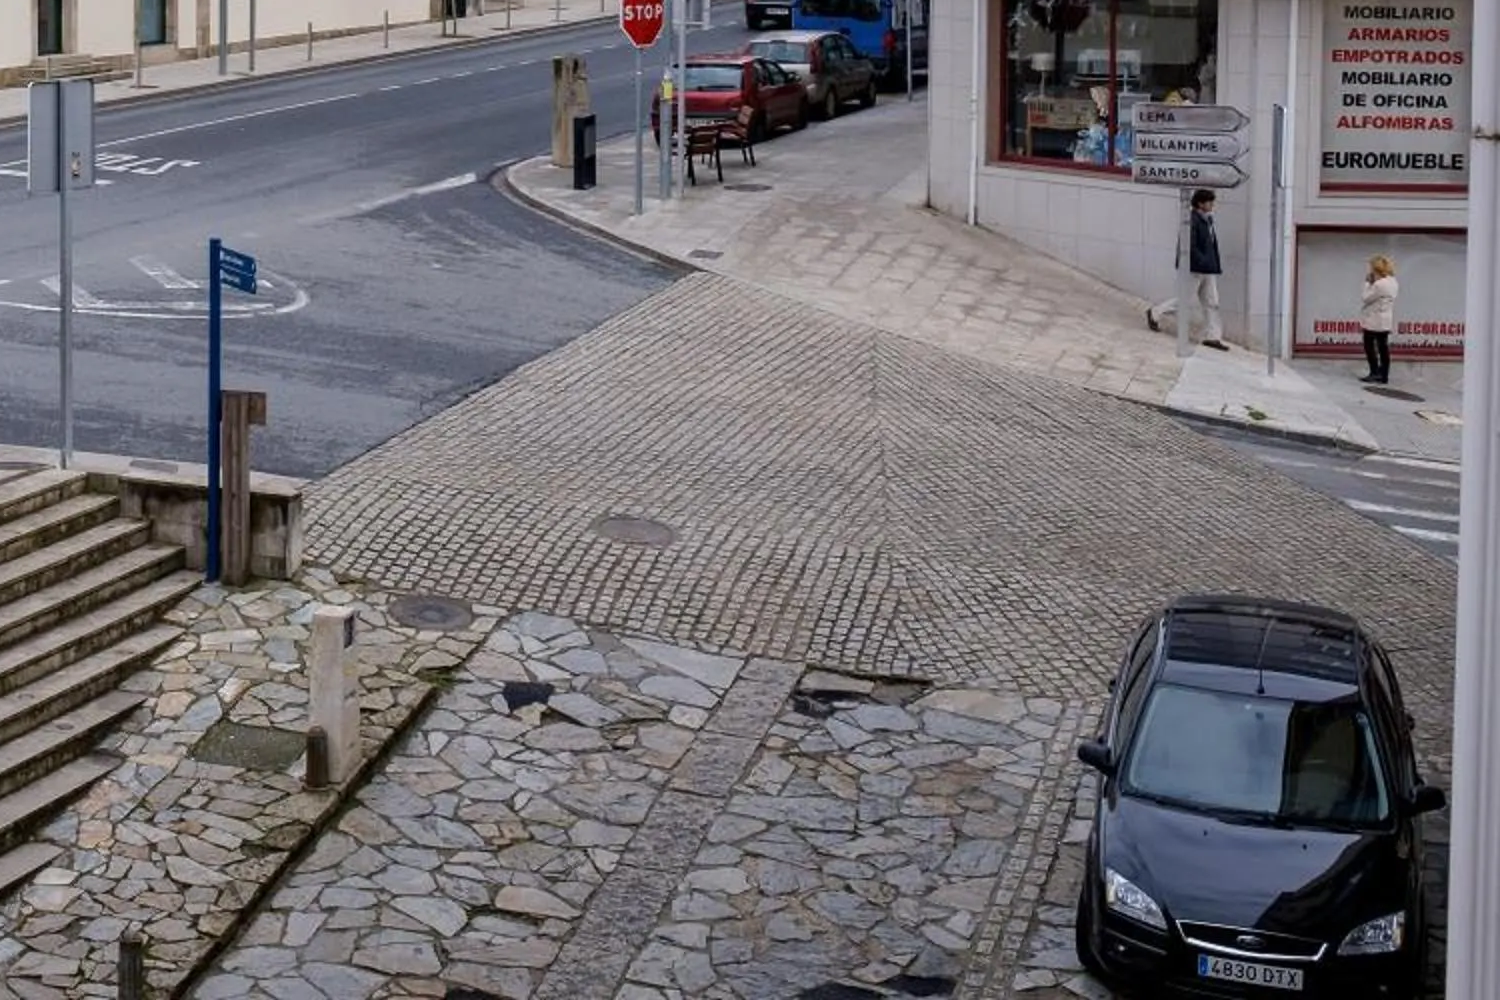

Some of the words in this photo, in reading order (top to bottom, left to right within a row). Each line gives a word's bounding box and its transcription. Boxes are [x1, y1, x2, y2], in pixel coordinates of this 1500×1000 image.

[624, 3, 664, 21] STOP
[1344, 5, 1456, 21] MOBILIARIO
[1347, 27, 1451, 43] ARMARIOS
[1331, 49, 1465, 65] EMPOTRADOS
[1341, 71, 1453, 87] MOBILIARIO
[1342, 93, 1366, 108] DE
[1373, 93, 1449, 109] OFICINA
[1139, 110, 1177, 123] LEMA
[1336, 115, 1455, 131] ALFOMBRAS
[1139, 138, 1220, 153] VILLANTIME
[1322, 152, 1465, 171] EUROMUEBLE
[1139, 165, 1201, 179] SANTISO
[1211, 959, 1258, 981] 4830
[1263, 966, 1298, 988] DTX
